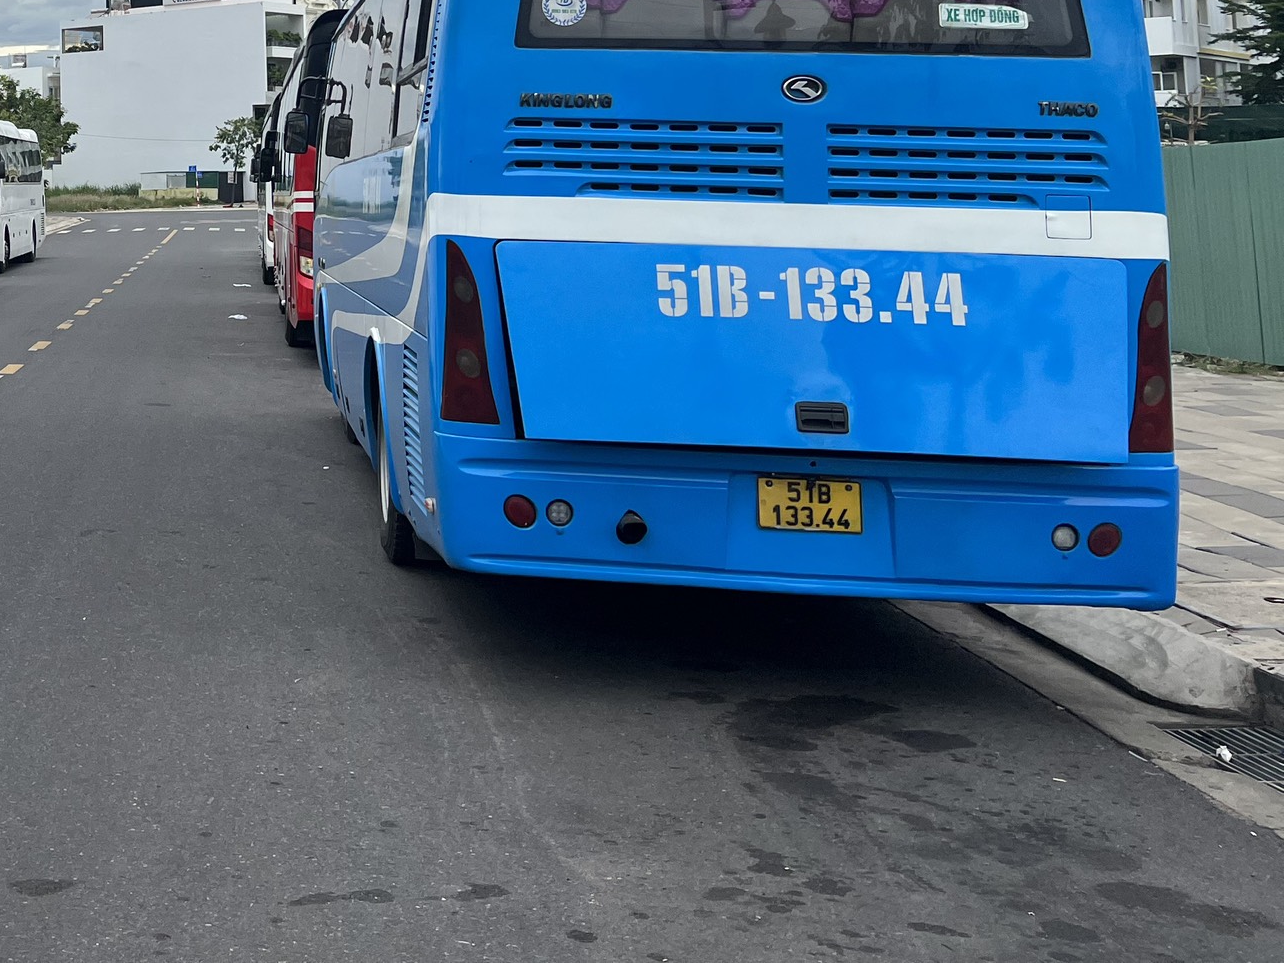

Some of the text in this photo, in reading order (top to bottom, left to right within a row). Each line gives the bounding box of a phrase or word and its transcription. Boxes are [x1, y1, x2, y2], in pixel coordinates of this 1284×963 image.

[946, 6, 1020, 25] XE HỢP ĐỒNG
[519, 93, 613, 108] KINGLONG
[1038, 101, 1099, 118] THACO
[656, 264, 968, 326] 51B-133.44
[787, 481, 831, 504] 51B
[772, 504, 851, 530] 133.44
